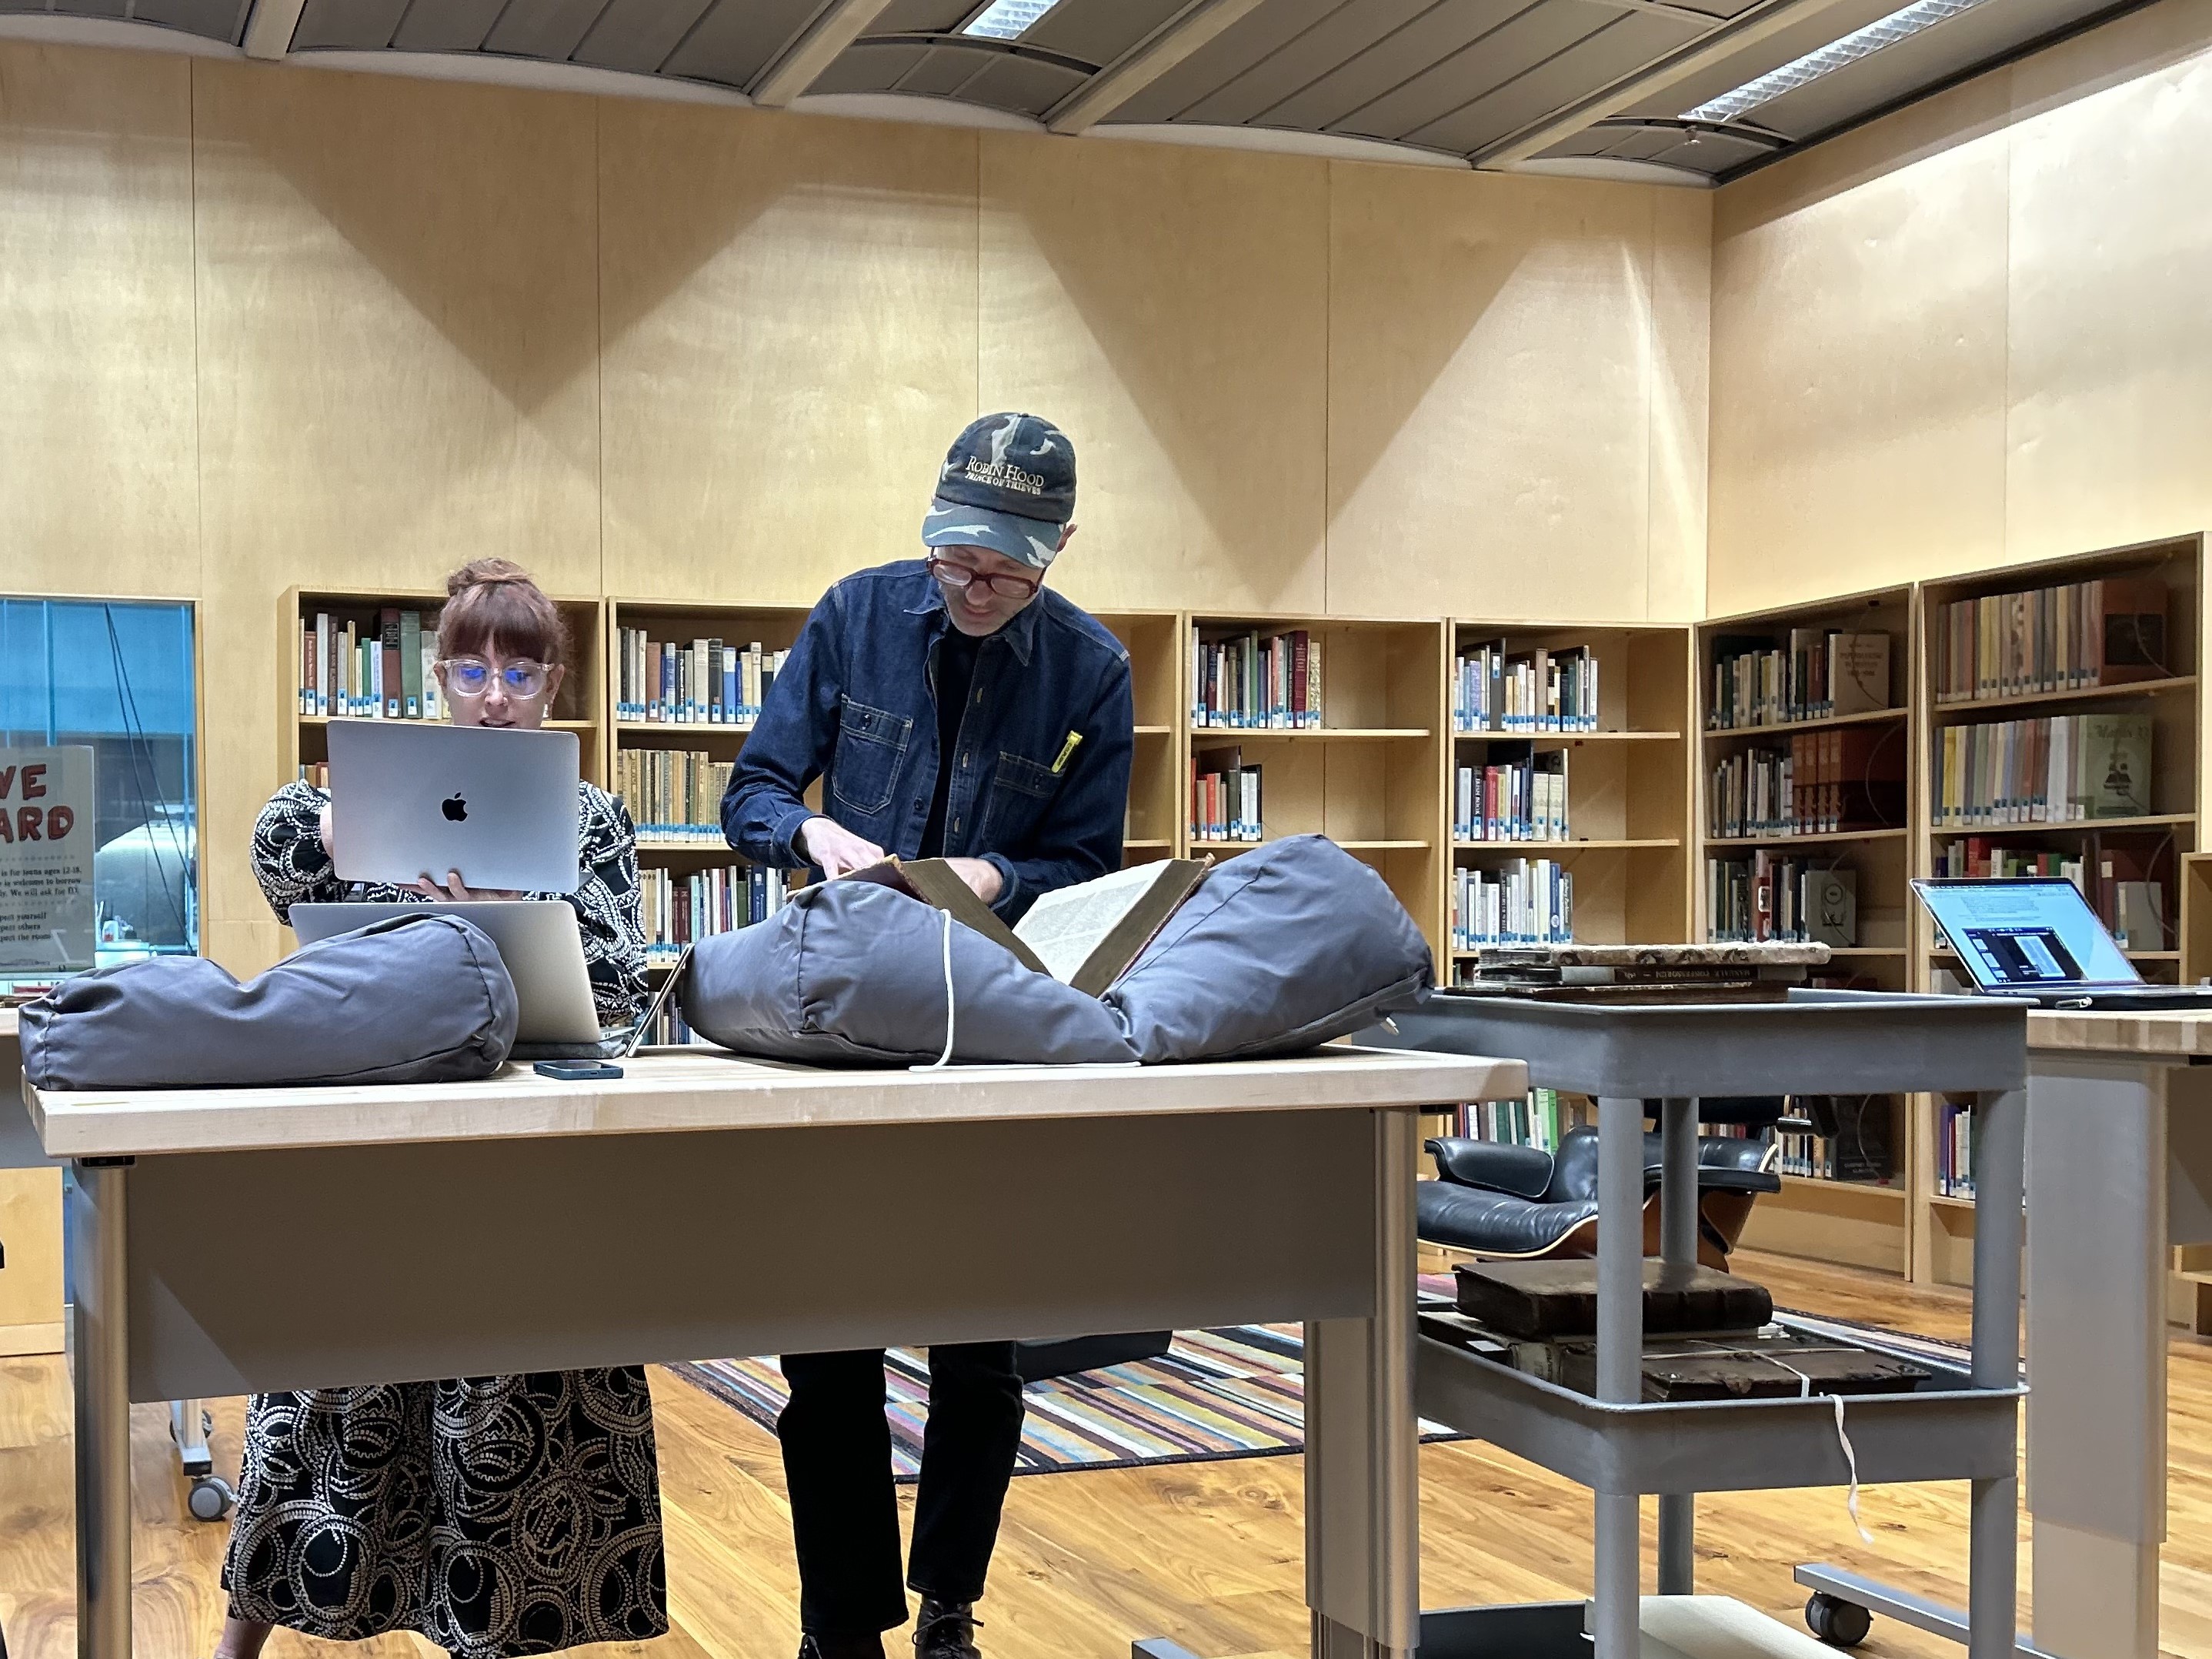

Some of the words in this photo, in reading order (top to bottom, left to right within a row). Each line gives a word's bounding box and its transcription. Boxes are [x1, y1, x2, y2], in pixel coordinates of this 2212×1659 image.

[965, 472, 993, 484] PRINCE
[993, 477, 1004, 487] OF
[1006, 479, 1041, 495] THIEVES
